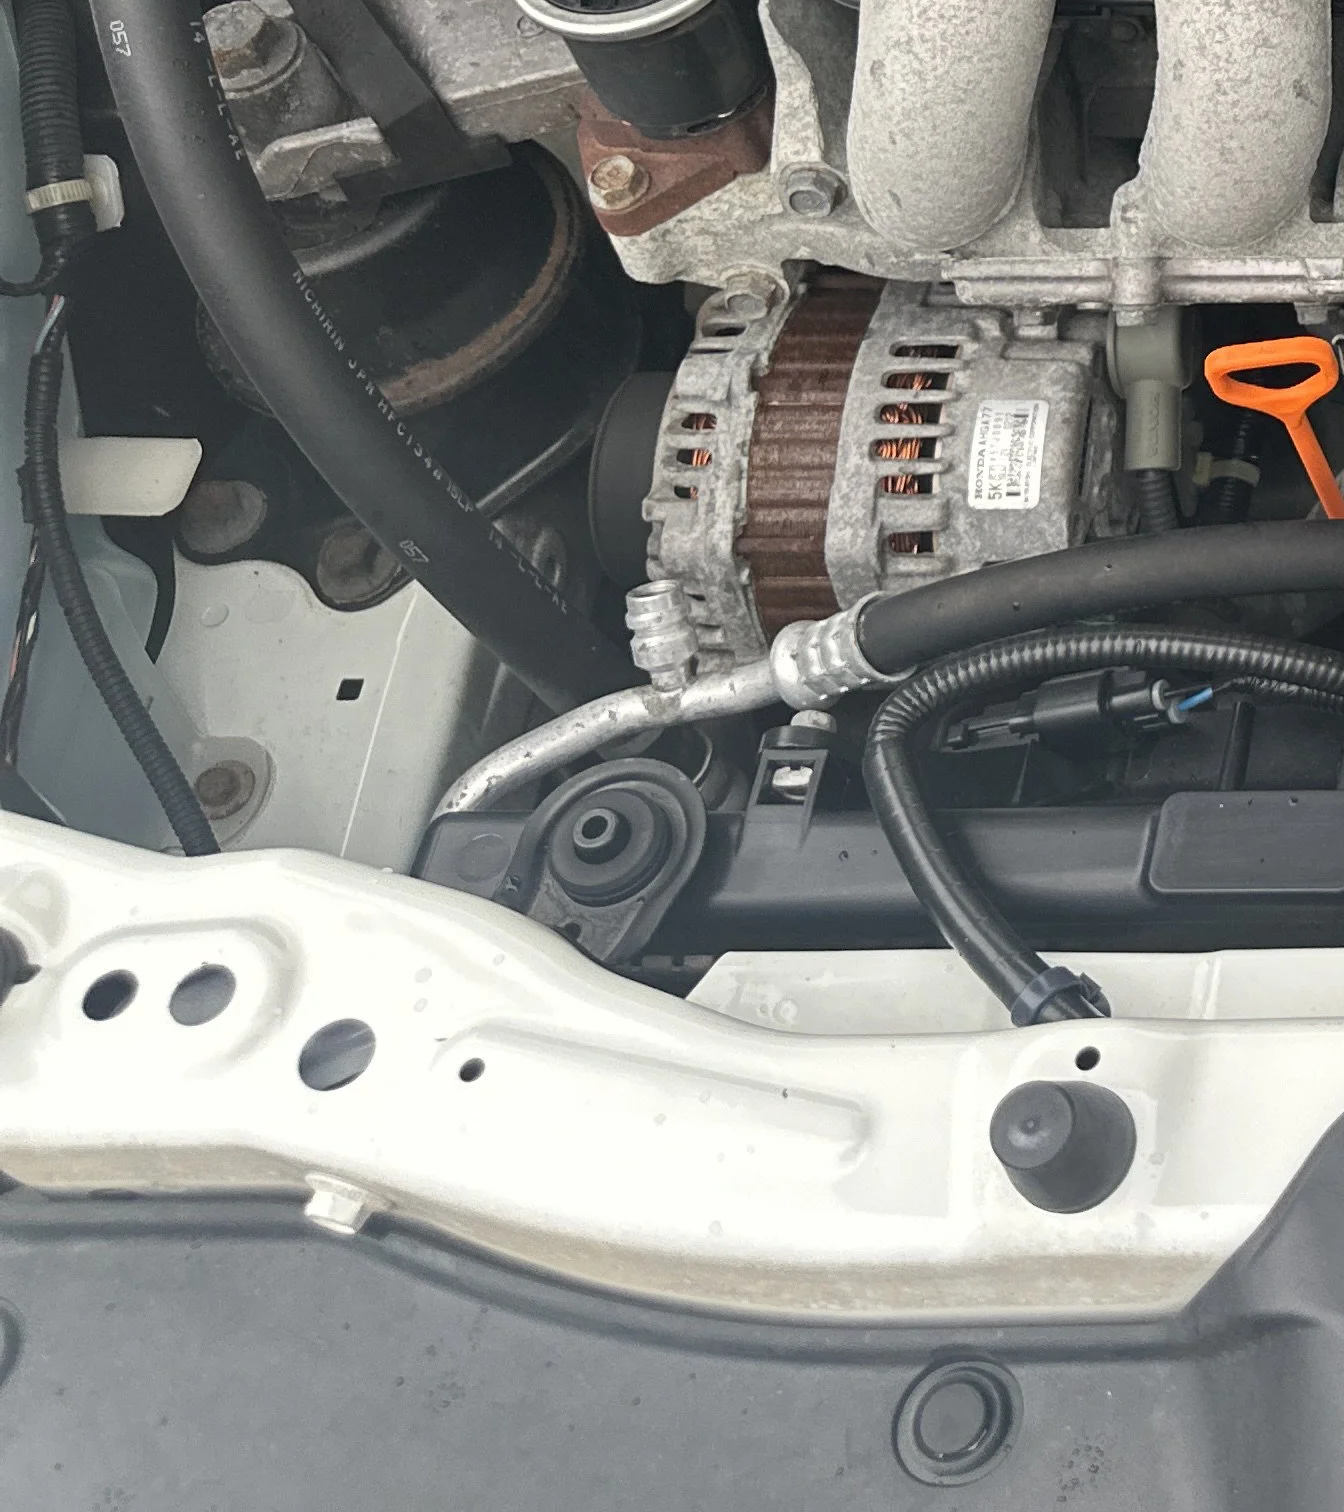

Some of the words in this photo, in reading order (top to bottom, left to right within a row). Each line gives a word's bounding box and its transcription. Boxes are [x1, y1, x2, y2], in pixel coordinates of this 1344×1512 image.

[109, 19, 132, 58] 057
[293, 268, 346, 352] NICHIRIN
[974, 448, 987, 500] HONDA
